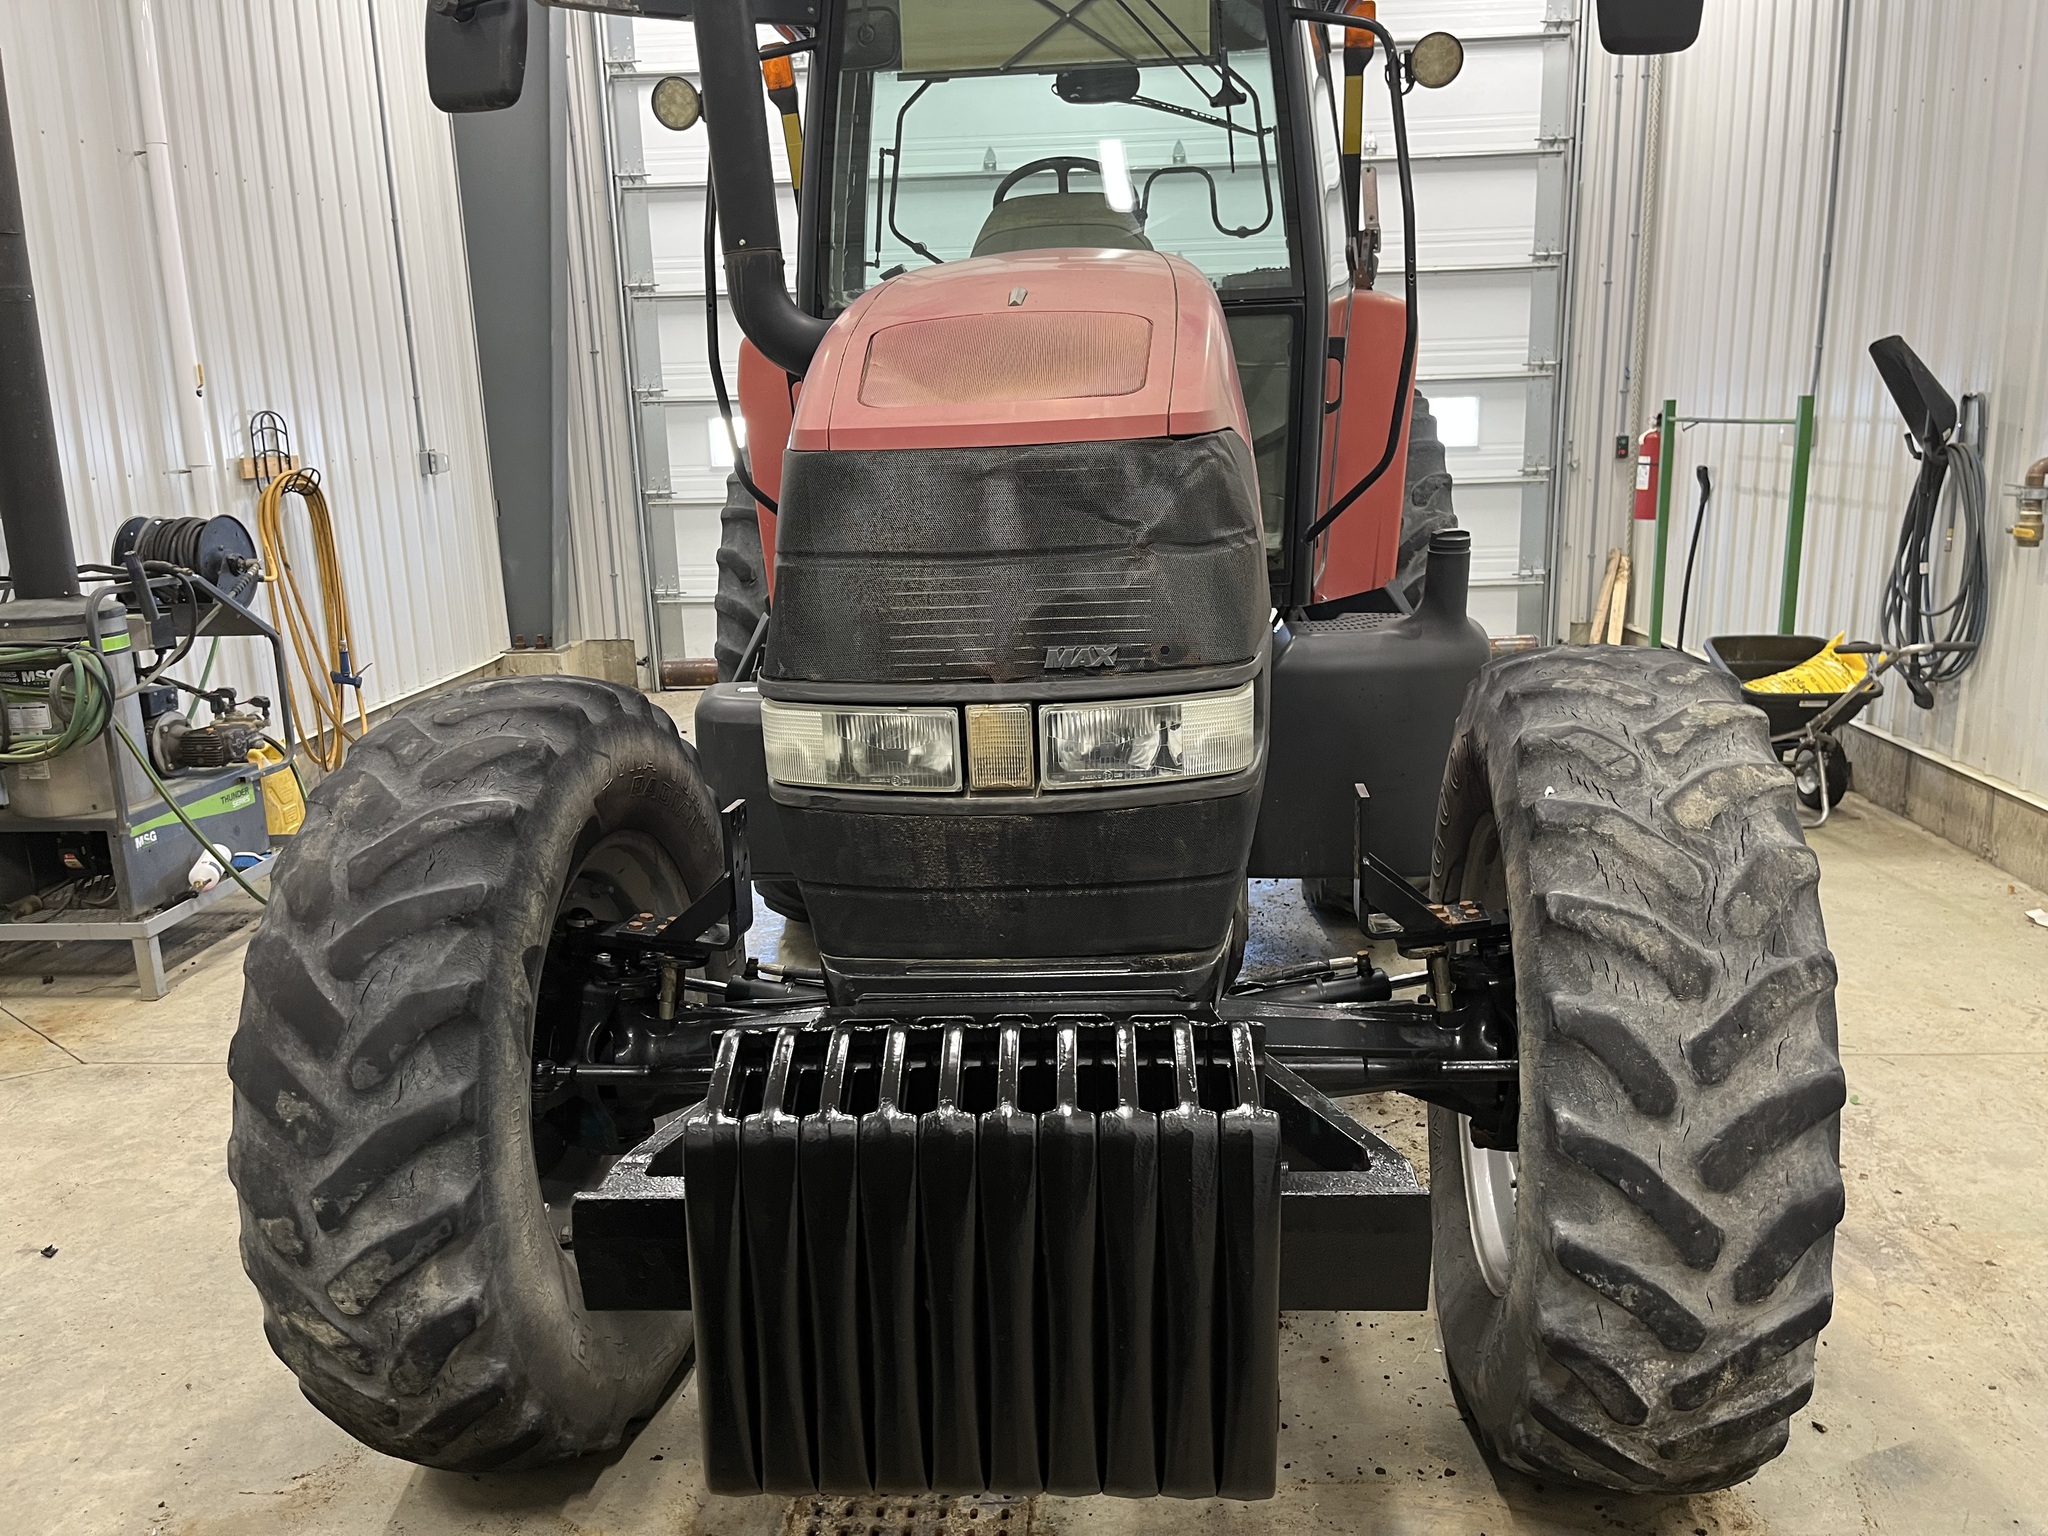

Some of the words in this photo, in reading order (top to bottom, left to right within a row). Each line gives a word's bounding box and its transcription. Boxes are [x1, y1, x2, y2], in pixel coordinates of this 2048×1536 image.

[1043, 645, 1118, 670] MAX
[220, 786, 250, 804] THUNDER
[232, 795, 251, 808] SERIES
[134, 830, 158, 849] MSG
